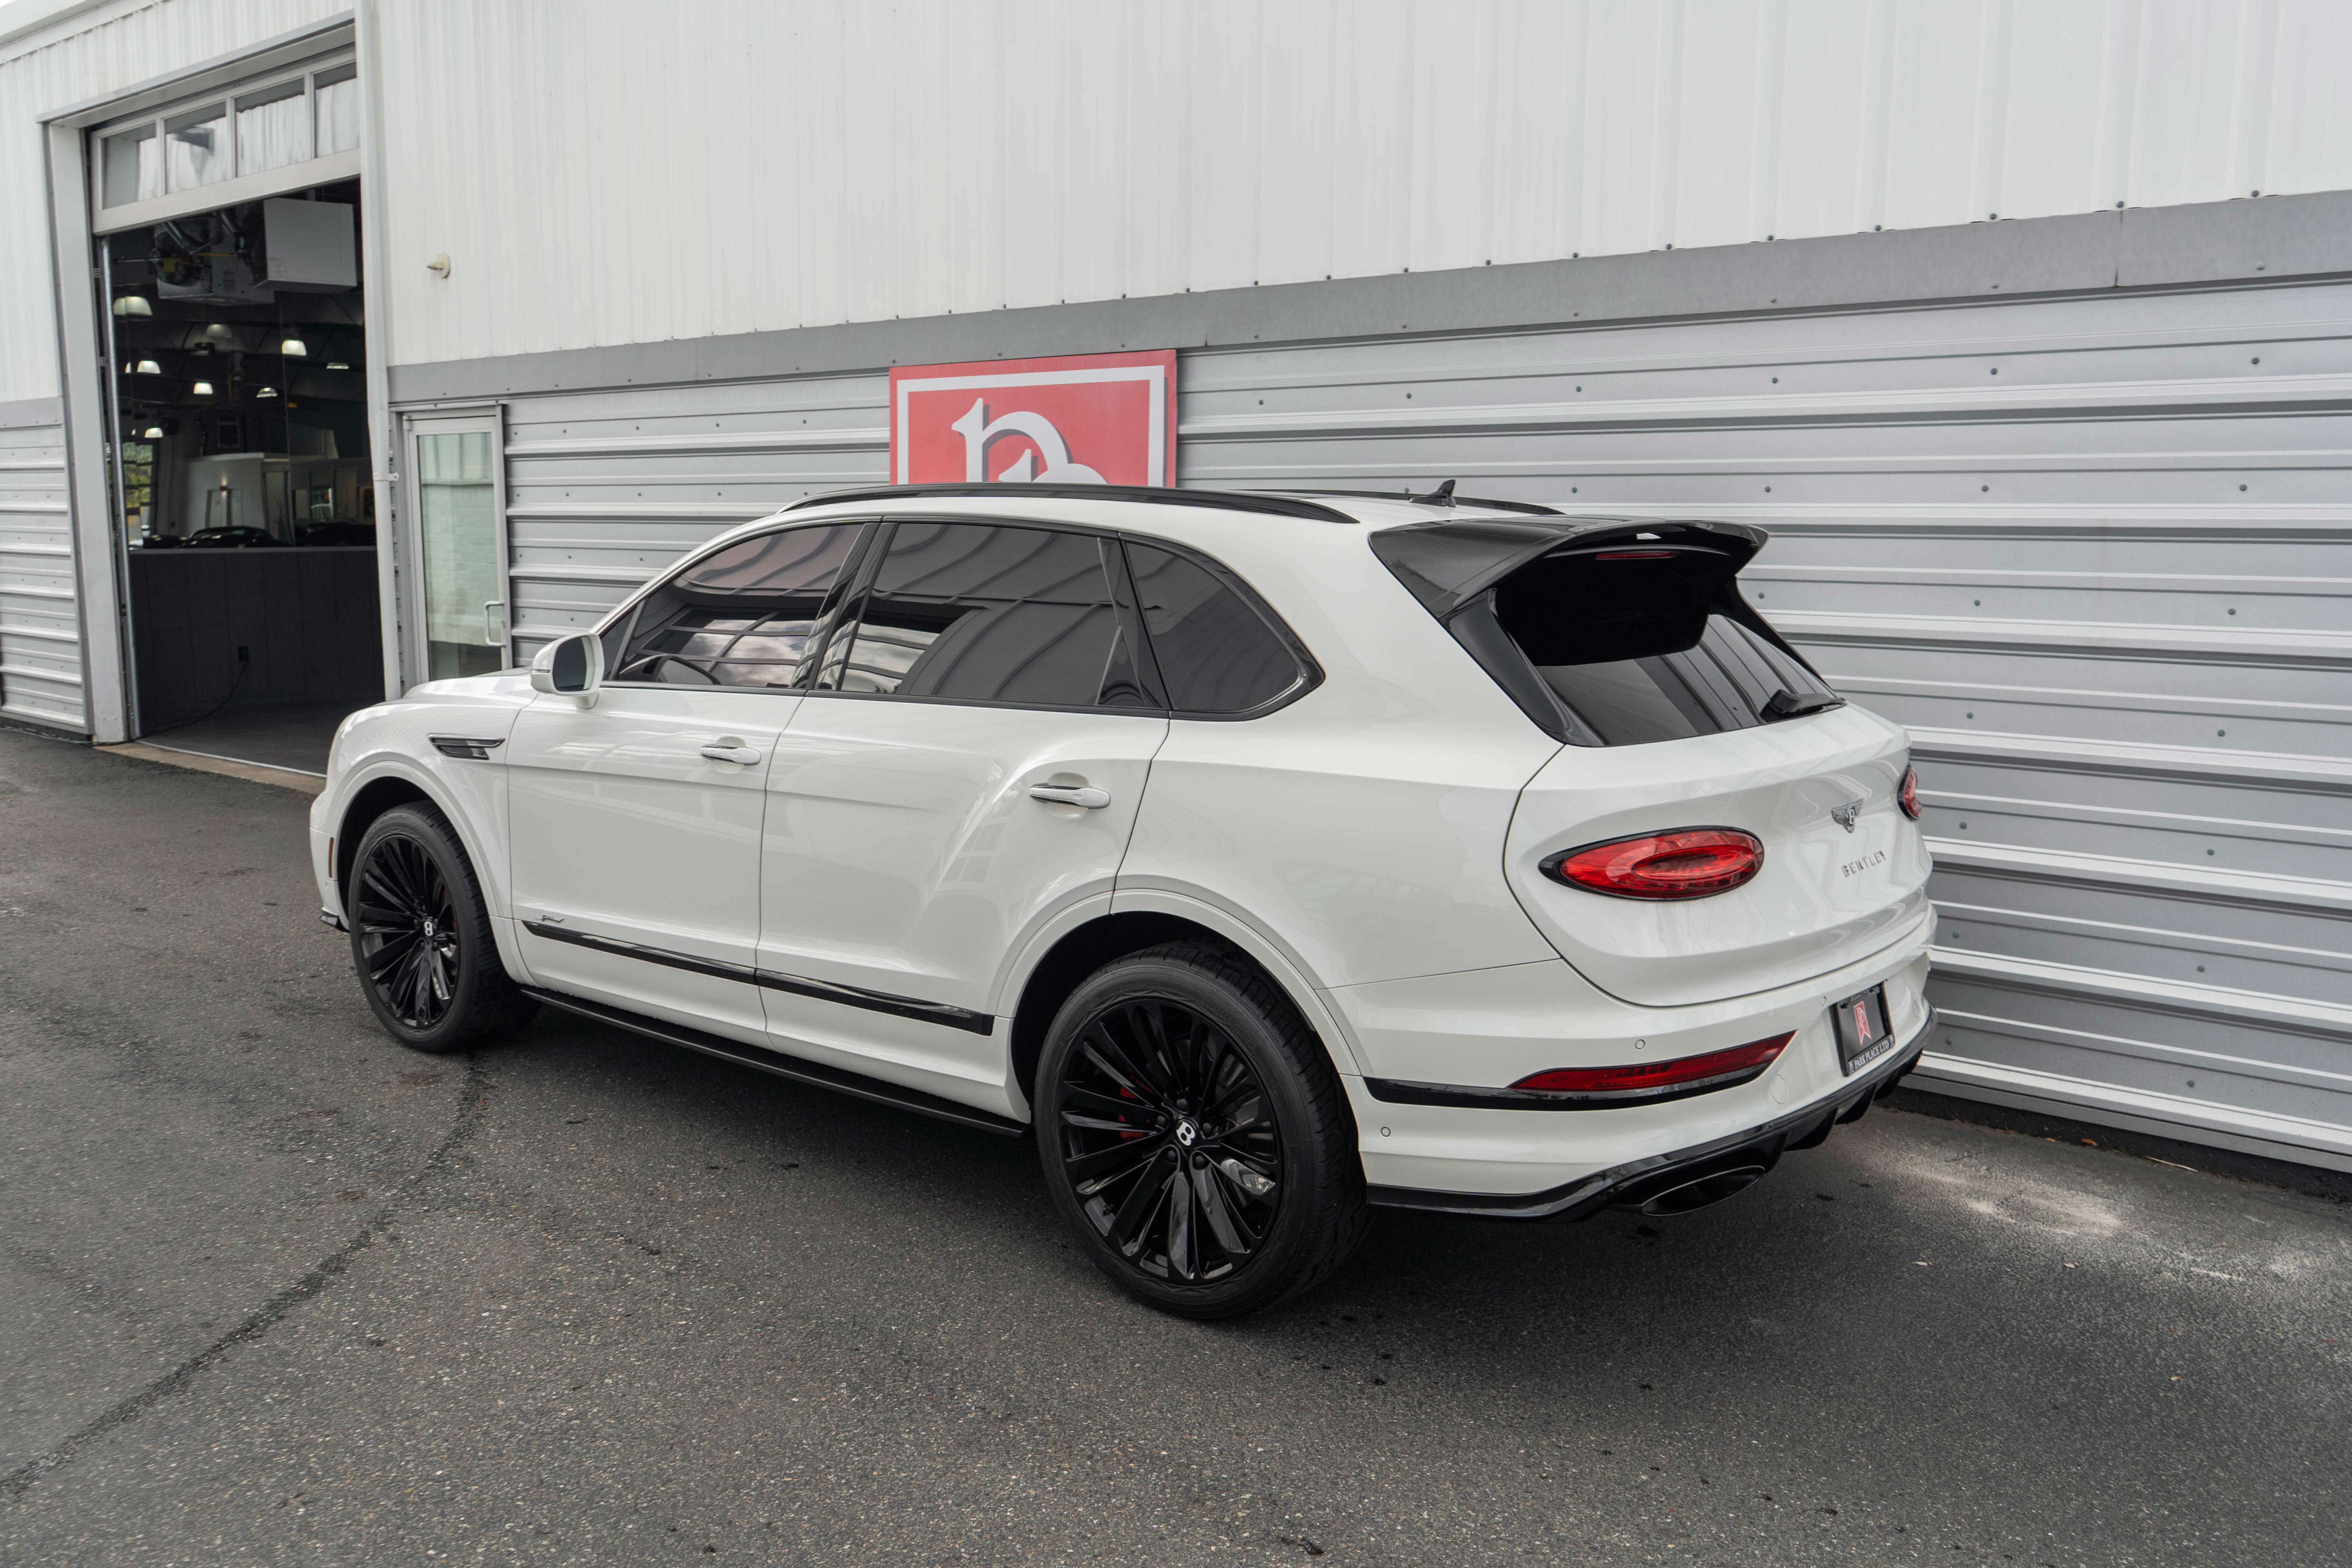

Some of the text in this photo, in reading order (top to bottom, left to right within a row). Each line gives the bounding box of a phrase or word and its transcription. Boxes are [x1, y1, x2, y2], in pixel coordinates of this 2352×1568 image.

[1841, 851, 1886, 877] BENTLEY
[1854, 1054, 1866, 1069] PARK
[1865, 1045, 1880, 1062] PLACE
[1879, 1040, 1889, 1053] LTD
[1176, 1121, 1196, 1146] B
